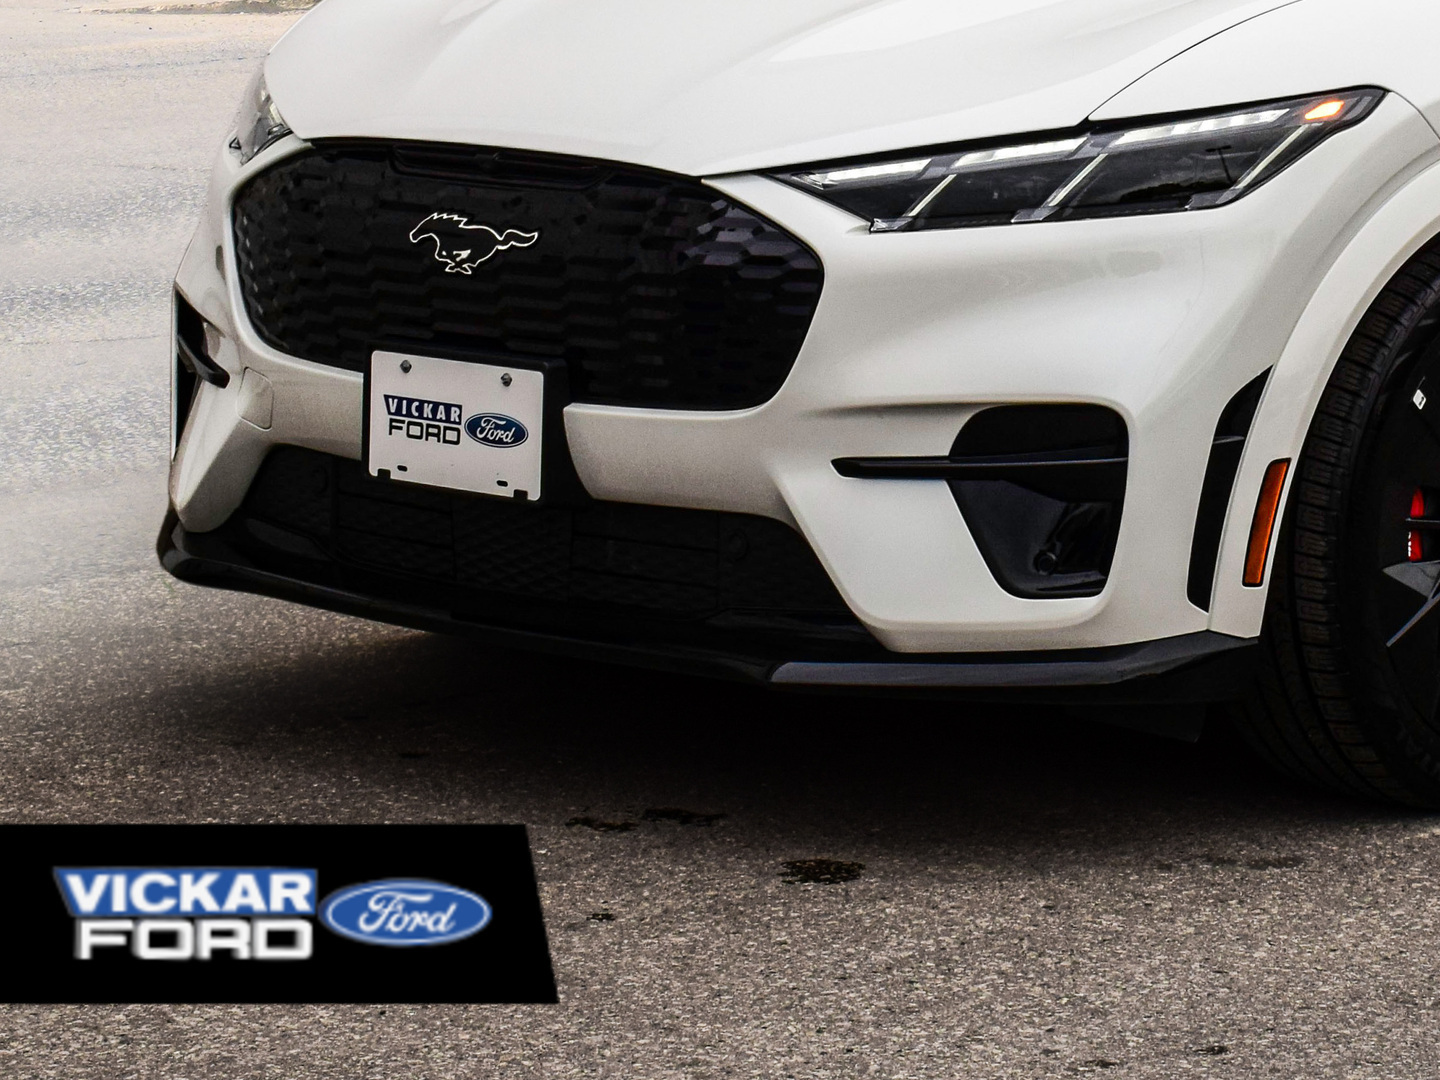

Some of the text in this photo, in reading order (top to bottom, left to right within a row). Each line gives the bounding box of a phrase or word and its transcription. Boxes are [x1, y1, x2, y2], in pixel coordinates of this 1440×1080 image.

[387, 397, 461, 424] VICKAR
[387, 417, 461, 446] FORD
[476, 416, 516, 443] Ford
